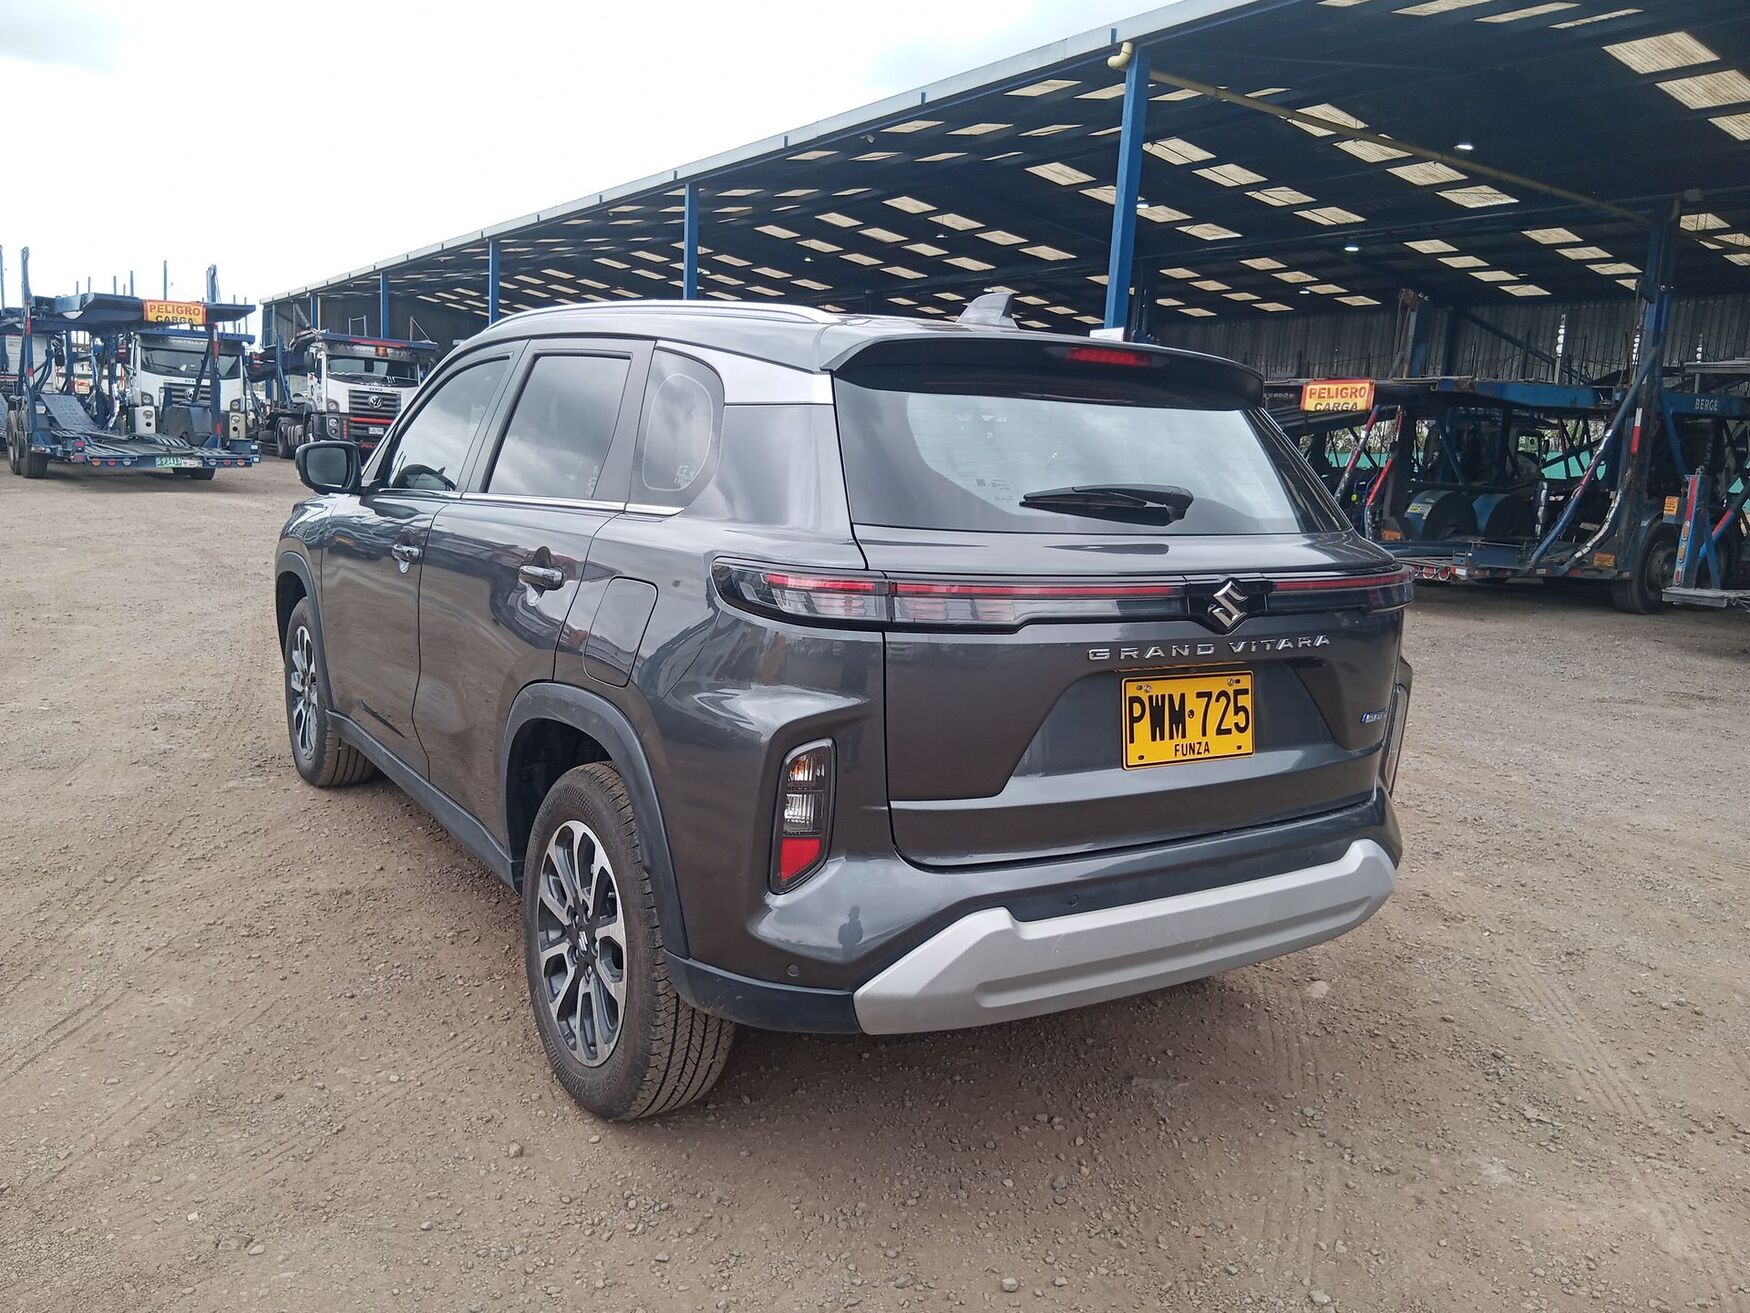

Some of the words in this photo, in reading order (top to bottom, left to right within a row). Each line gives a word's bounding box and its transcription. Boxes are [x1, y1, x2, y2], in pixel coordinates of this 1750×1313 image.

[149, 304, 201, 316] PELIGRO
[155, 315, 194, 323] CARGA
[1308, 386, 1367, 399] PELIGRO
[1314, 401, 1358, 412] CARGA
[1088, 643, 1215, 661] GRAND
[1229, 635, 1331, 653] VITARA
[1174, 741, 1211, 757] FUNZA
